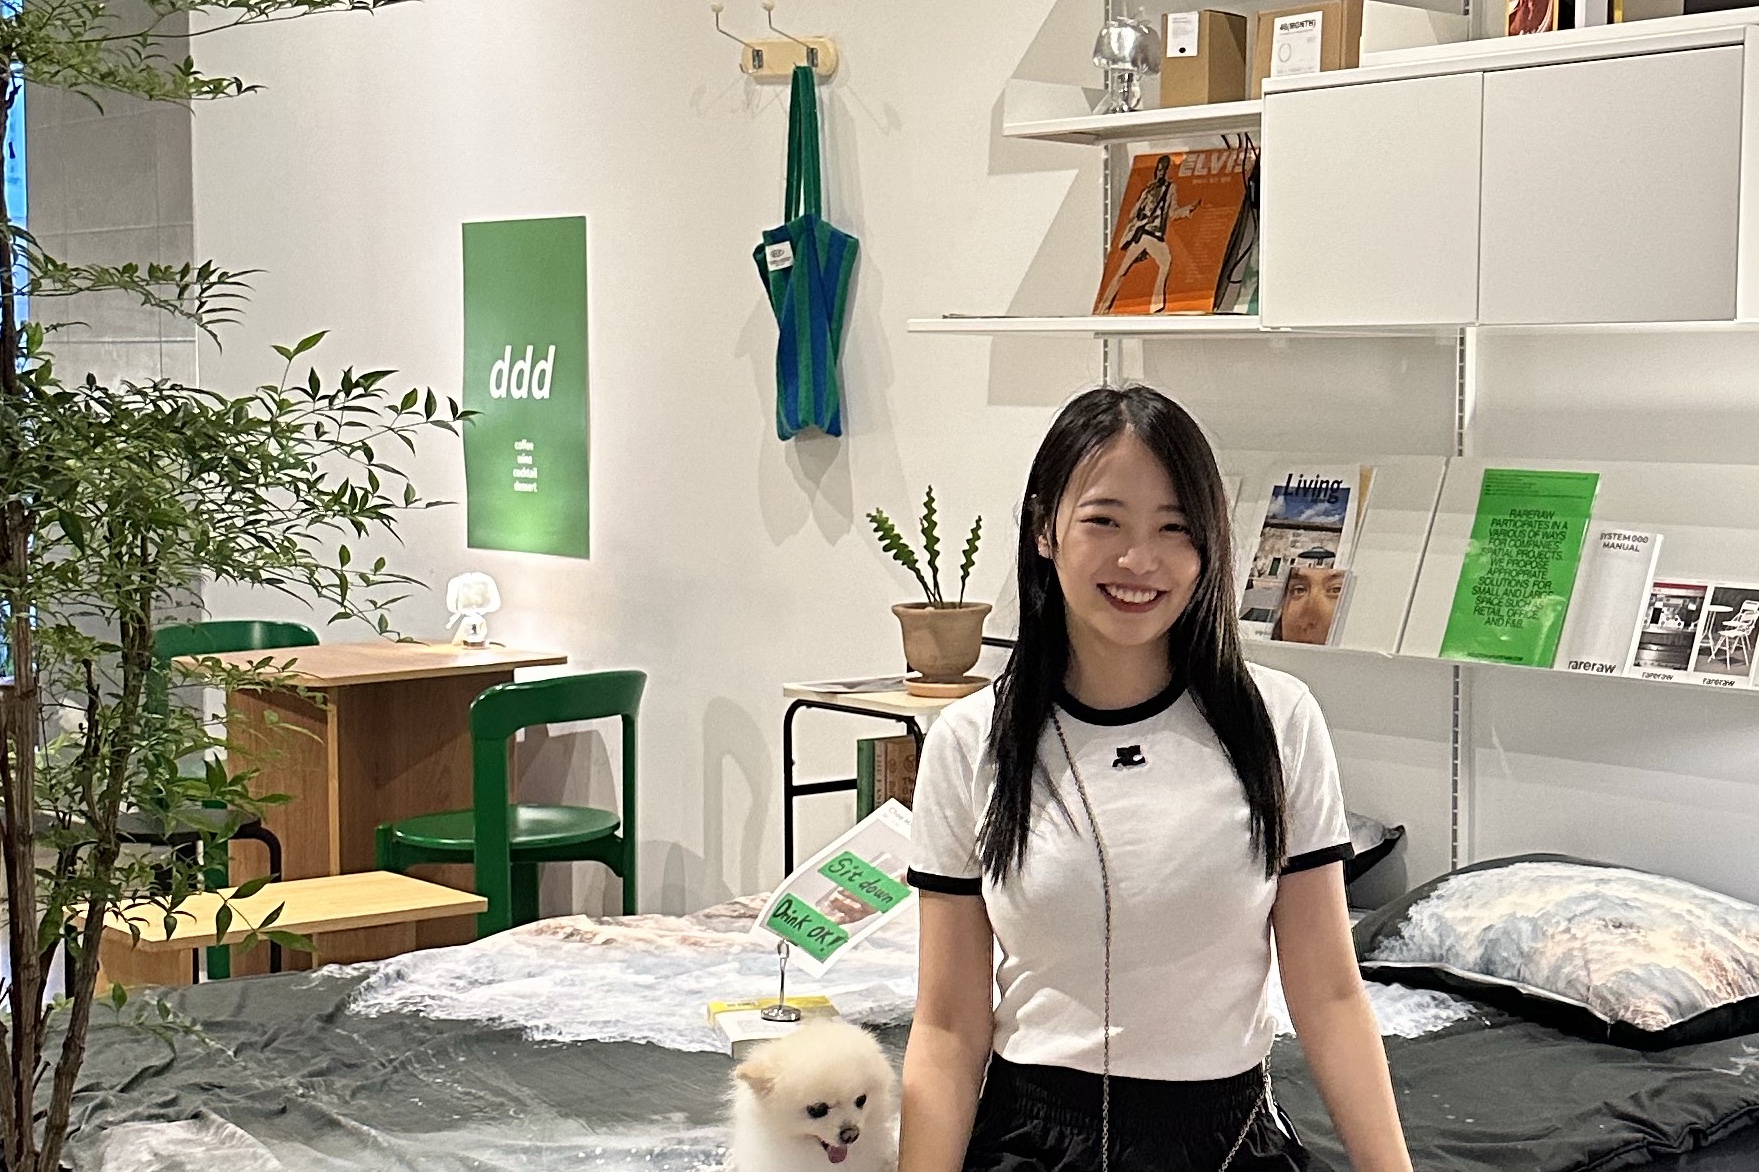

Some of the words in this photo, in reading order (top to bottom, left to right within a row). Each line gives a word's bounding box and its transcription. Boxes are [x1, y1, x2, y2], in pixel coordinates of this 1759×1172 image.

[489, 344, 556, 400] ddd
[514, 438, 534, 451] coffee
[516, 452, 533, 465] wine
[512, 467, 538, 479] cocktail
[513, 480, 538, 493] dessert
[1283, 472, 1343, 504] Living
[1509, 508, 1555, 520] RARERAW
[1490, 517, 1550, 530] PARTICIPATES
[1488, 528, 1527, 539] VARIOUS
[1527, 530, 1541, 540] OF
[1541, 530, 1567, 541] WAYS
[1600, 532, 1631, 542] SYSTEM
[1488, 538, 1507, 547] FOR
[1602, 541, 1640, 552] MANUAL
[1490, 557, 1505, 567] WE
[1505, 559, 1550, 570] PROPOSE
[1486, 568, 1548, 580] APPROPRIATE
[1477, 577, 1529, 588] SOLUTIONS
[1532, 579, 1553, 590] FOR
[1471, 586, 1500, 597] SMALL
[1502, 588, 1523, 598] AND
[1475, 596, 1503, 607] SPACE
[1505, 598, 1531, 608] SUCH
[1484, 616, 1504, 627] AND
[1567, 660, 1617, 674] rareraw
[1641, 671, 1674, 681] rareraw
[1702, 677, 1736, 687] rareraw
[828, 858, 865, 883] Sit
[860, 878, 894, 905] down
[772, 898, 813, 932] Drink
[806, 925, 846, 954] OK!
